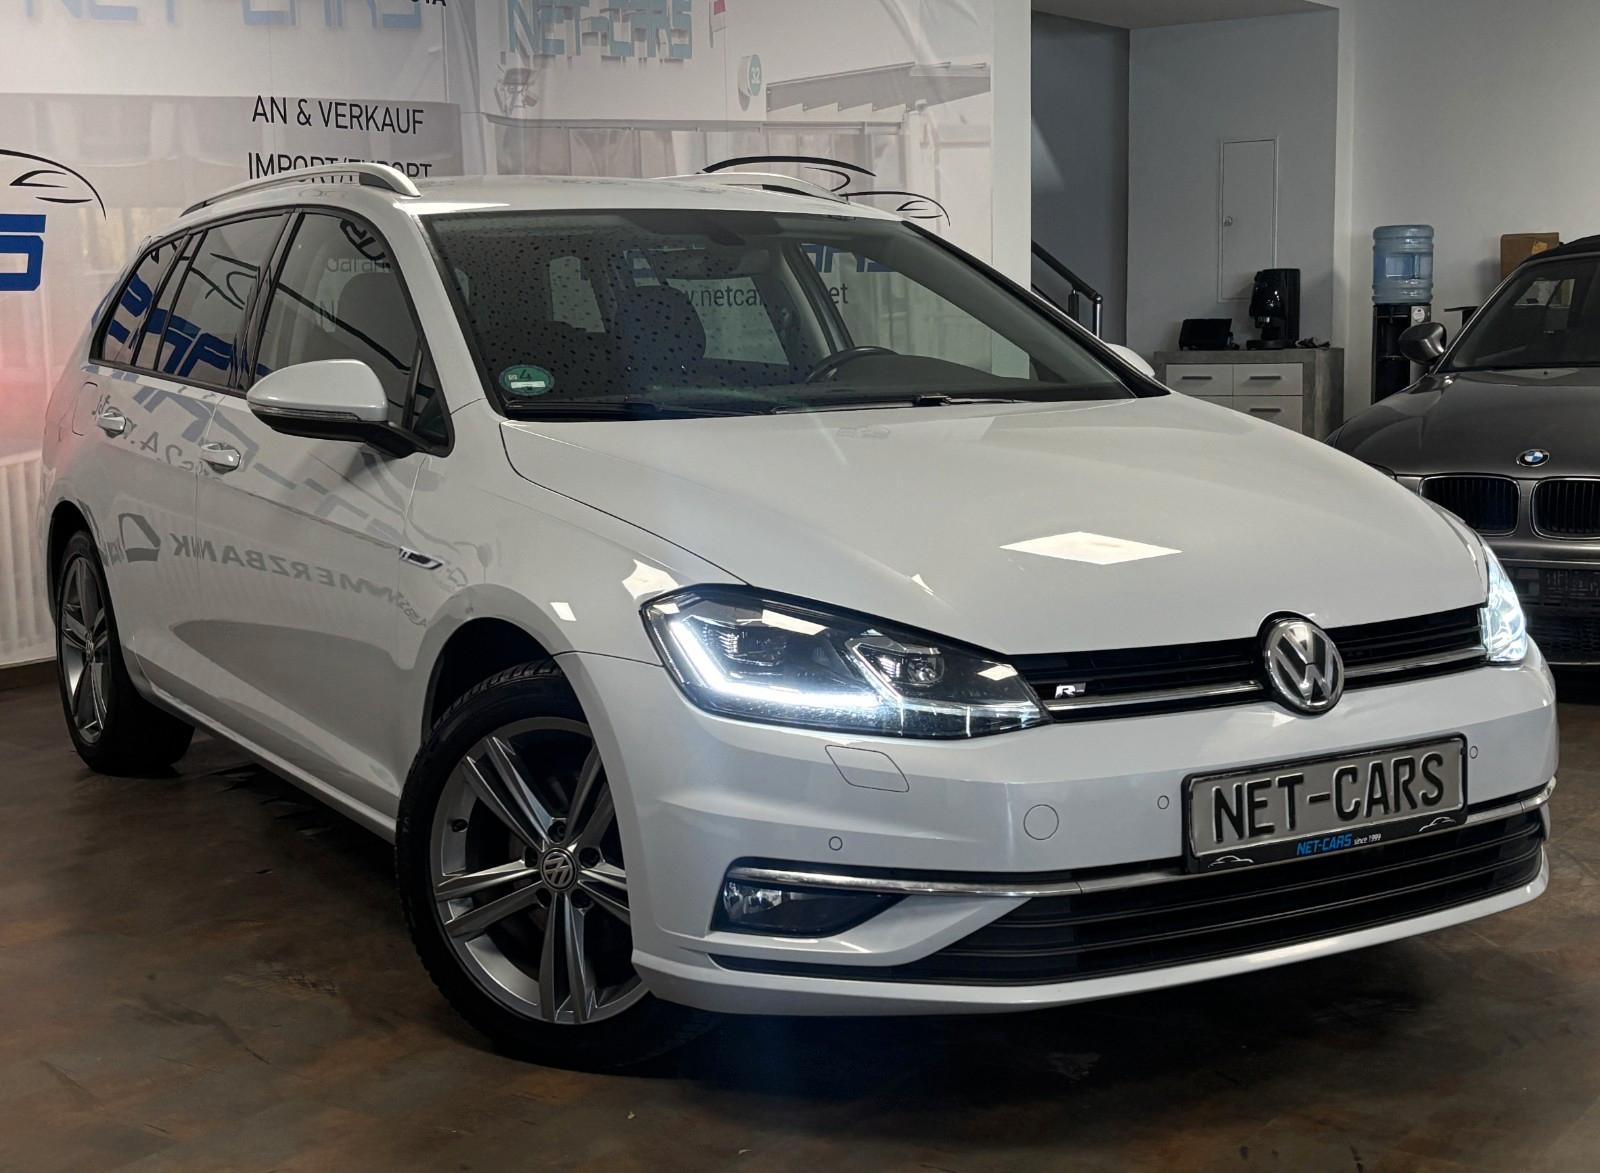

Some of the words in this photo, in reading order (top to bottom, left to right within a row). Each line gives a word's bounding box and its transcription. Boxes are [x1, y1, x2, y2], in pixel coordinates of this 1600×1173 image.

[251, 95, 288, 124] AN
[296, 98, 312, 127] &
[318, 100, 424, 135] VERKAUF
[1212, 751, 1444, 843] NET-CARS
[1296, 833, 1353, 856] NET-CARS
[1353, 837, 1369, 846] since
[1368, 833, 1382, 843] 1999
